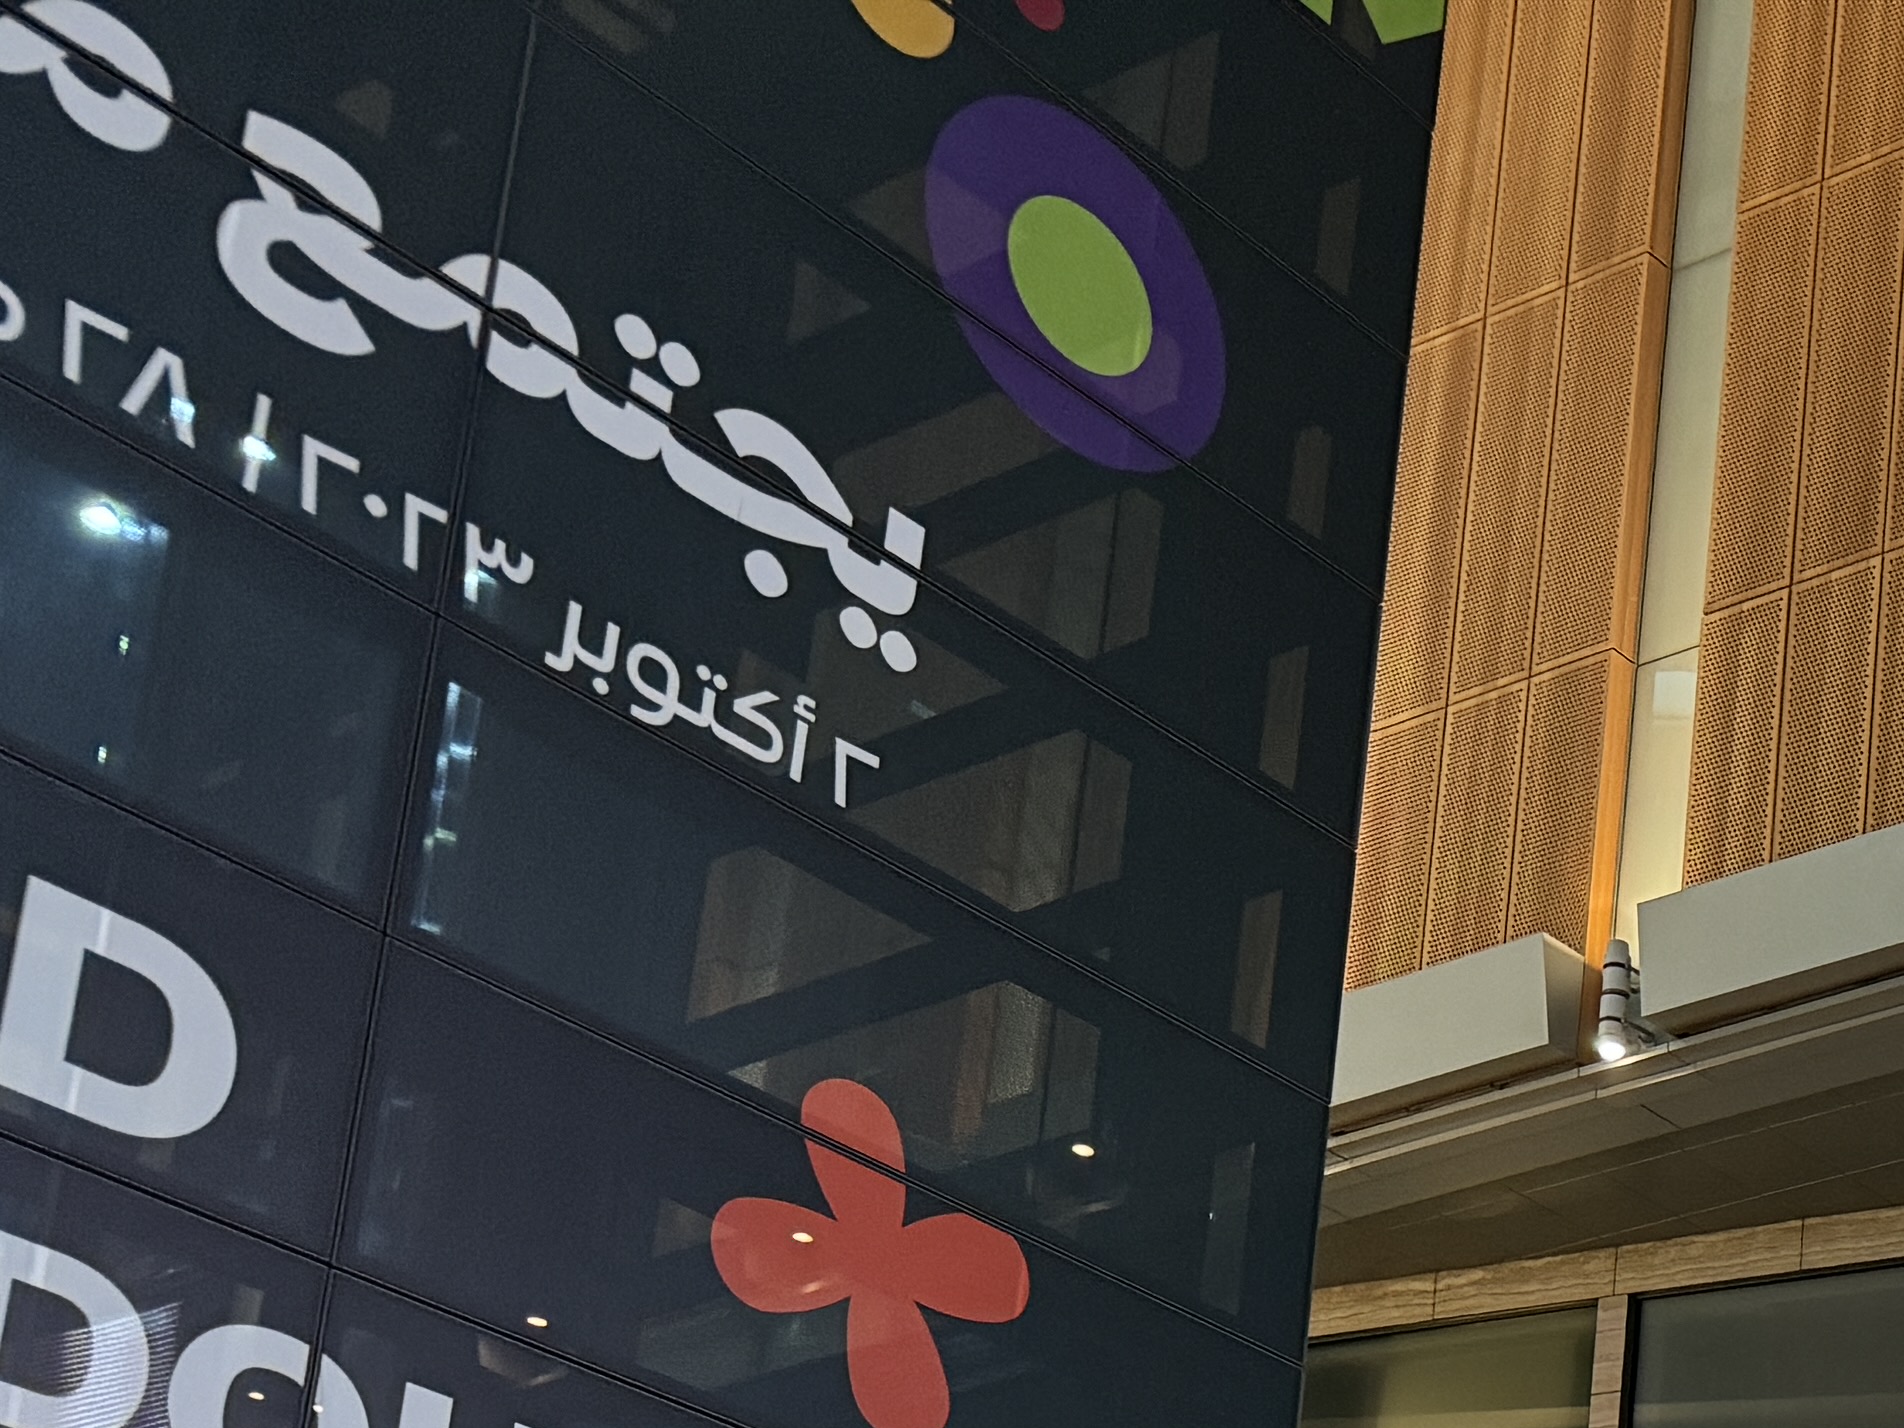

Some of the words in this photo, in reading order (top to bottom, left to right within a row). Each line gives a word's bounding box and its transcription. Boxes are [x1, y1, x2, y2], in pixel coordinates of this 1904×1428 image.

[217, 110, 926, 673] يجتمع
[302, 433, 535, 604] ٢٠٢٣
[545, 598, 819, 784] أكتوبر
